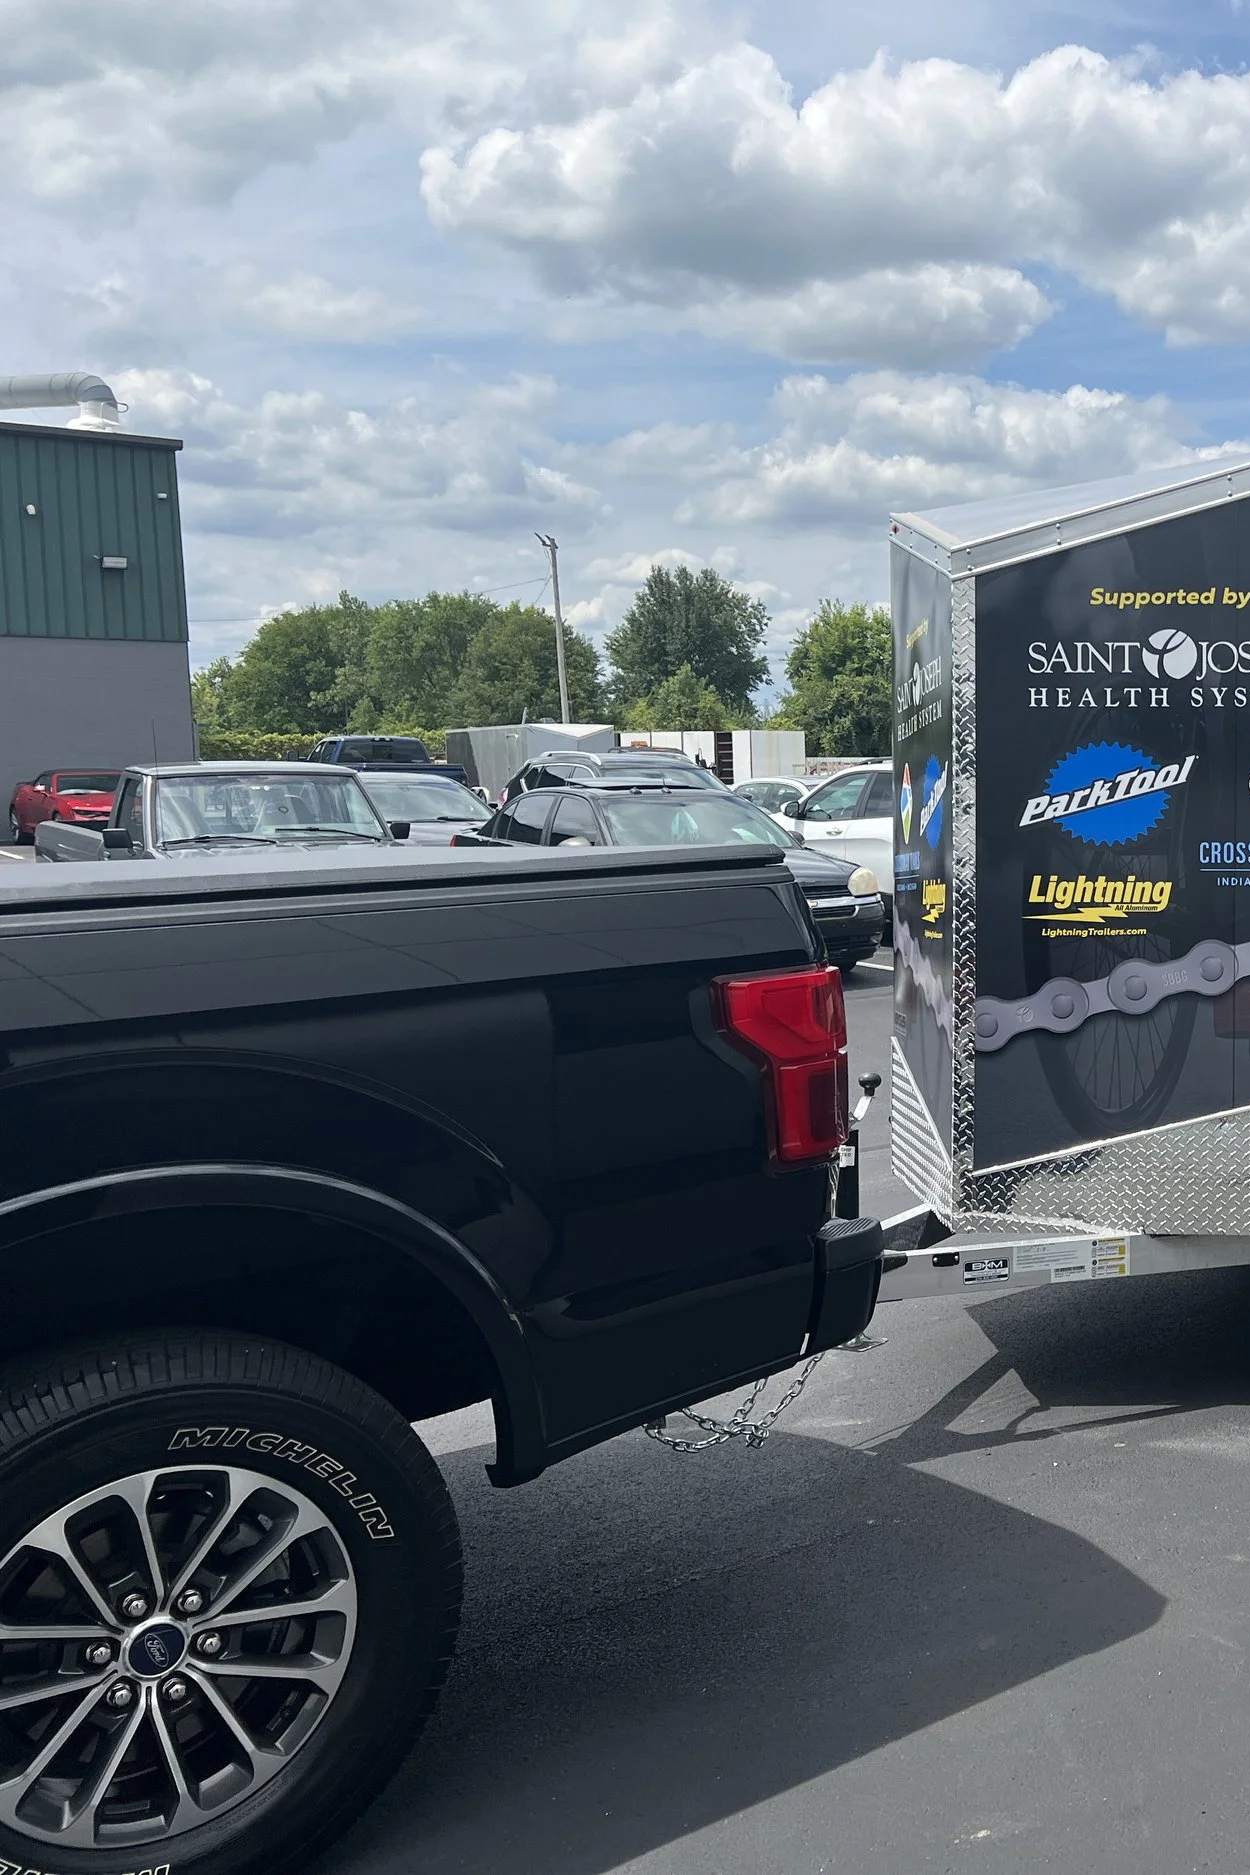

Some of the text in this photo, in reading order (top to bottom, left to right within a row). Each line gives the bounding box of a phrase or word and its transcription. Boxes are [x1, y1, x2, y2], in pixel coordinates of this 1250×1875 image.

[1089, 587, 1216, 609] Supported
[1028, 641, 1141, 674] SAINT
[1028, 687, 1170, 707] HEALTH
[1028, 875, 1173, 912] Lightning
[1125, 904, 1158, 912] Aluminum
[1042, 928, 1147, 938] LightningTrailers.com
[168, 1427, 394, 1539] MICHELIN
[146, 1638, 166, 1664] Ford
